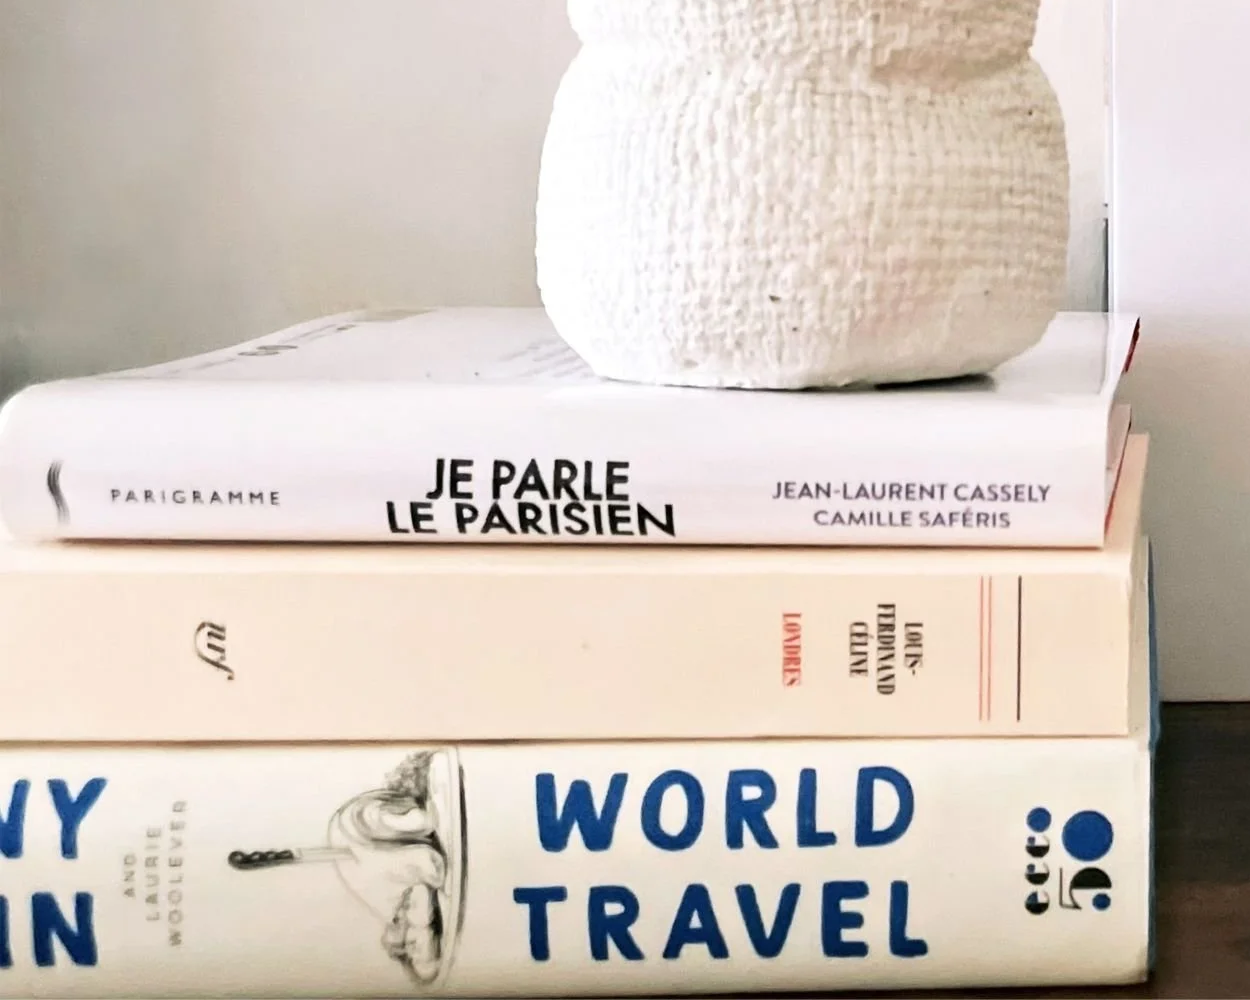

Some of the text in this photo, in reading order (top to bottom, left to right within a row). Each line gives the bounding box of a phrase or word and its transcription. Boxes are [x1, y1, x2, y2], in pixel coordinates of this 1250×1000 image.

[110, 488, 281, 506] PARIGRAMME
[426, 457, 630, 501] JE PARLE
[772, 481, 1051, 503] JEAN-LAURENT CASSELY
[385, 500, 677, 538] LE PARISIEN
[813, 504, 1011, 529] CAMILLE SAFÉRIS
[782, 612, 802, 687] LONDRES
[849, 621, 871, 678] CÉLINE
[877, 603, 896, 696] FERDINAND
[904, 621, 924, 676] LOUIS-
[535, 765, 915, 853] WORLD
[123, 854, 137, 898] AND
[145, 827, 162, 922] LAURIE
[167, 800, 188, 947] WOOLEVER
[512, 880, 929, 963] TRAVEL
